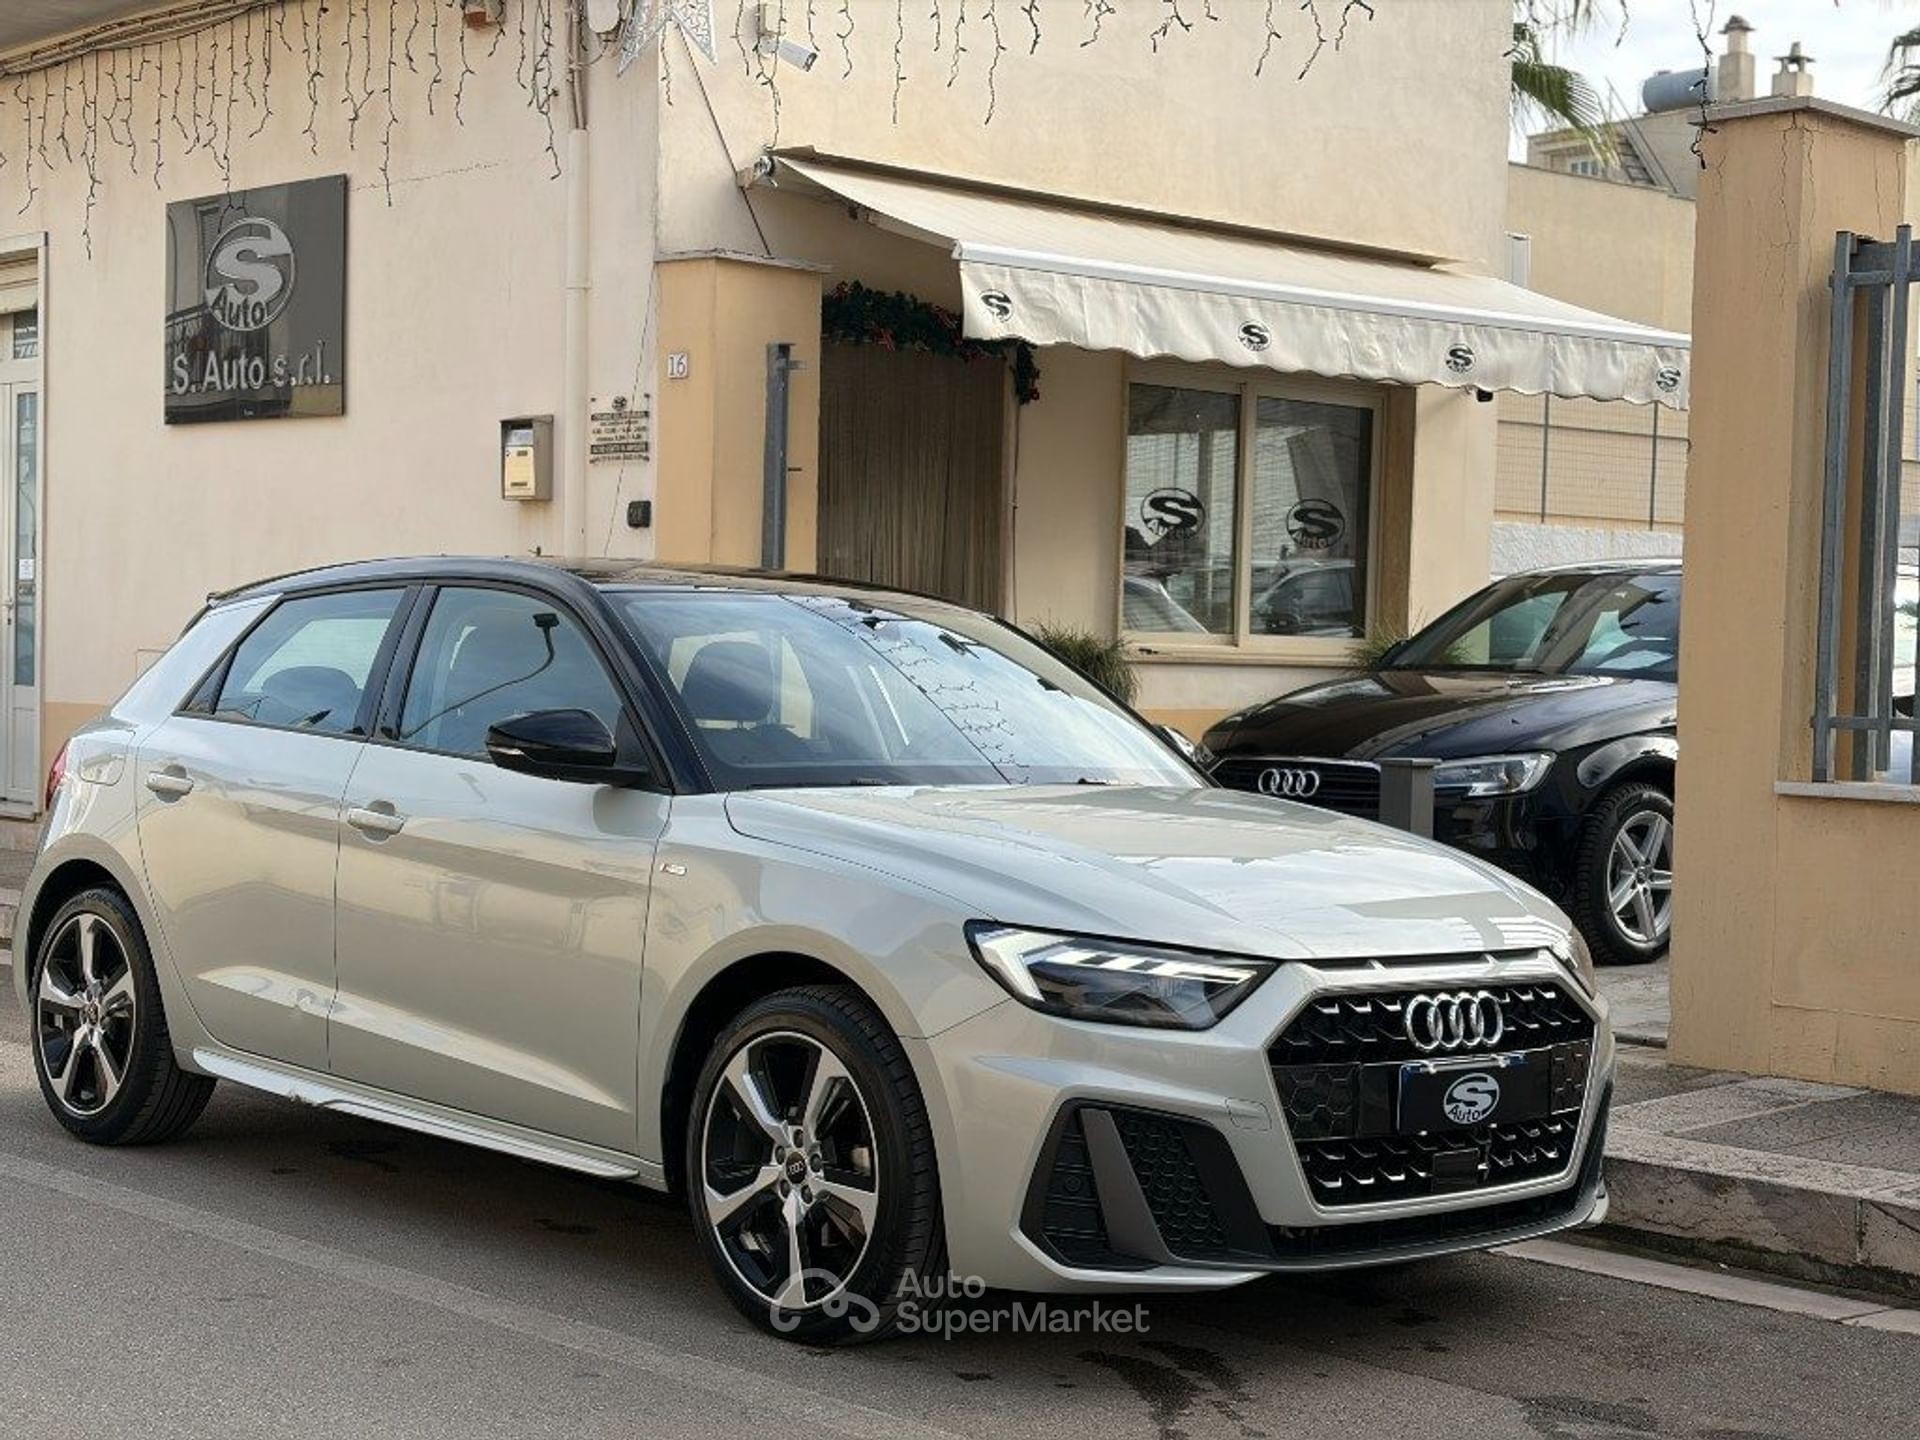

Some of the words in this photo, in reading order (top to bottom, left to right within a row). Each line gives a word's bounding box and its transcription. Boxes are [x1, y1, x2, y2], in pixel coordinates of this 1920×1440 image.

[212, 286, 266, 328] Auto
[669, 355, 686, 376] 16
[1292, 531, 1328, 550] Auto
[1448, 1105, 1481, 1122] Auto
